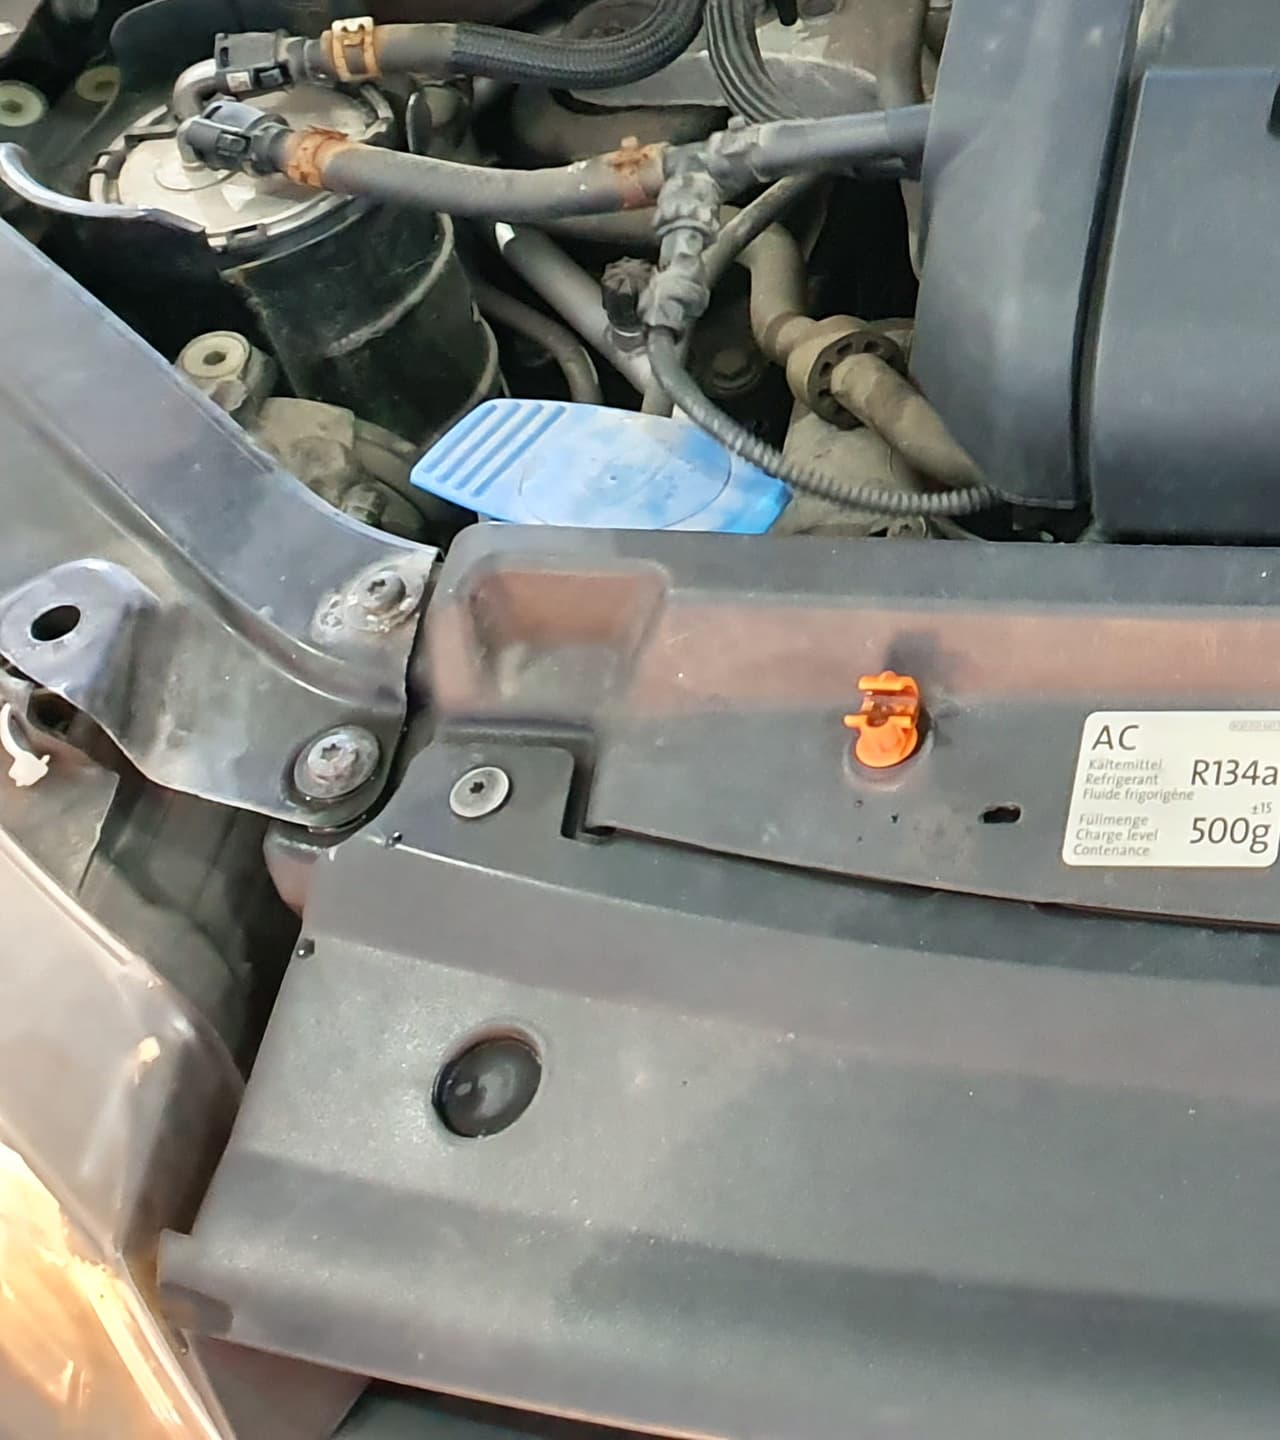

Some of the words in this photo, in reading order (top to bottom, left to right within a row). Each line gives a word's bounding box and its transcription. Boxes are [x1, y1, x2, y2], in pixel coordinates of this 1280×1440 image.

[1091, 724, 1140, 751] AC
[1088, 758, 1163, 771] Kältemittel
[1191, 759, 1279, 786] R134a
[1085, 773, 1159, 788] Refrigerant
[1082, 787, 1121, 800] Fluide
[1124, 787, 1195, 804] frigorigène
[1079, 813, 1149, 829] Füllmenge
[1075, 827, 1124, 844] Charge
[1126, 827, 1160, 841] level
[1189, 816, 1273, 854] 500g
[1073, 843, 1151, 857] Contenance
